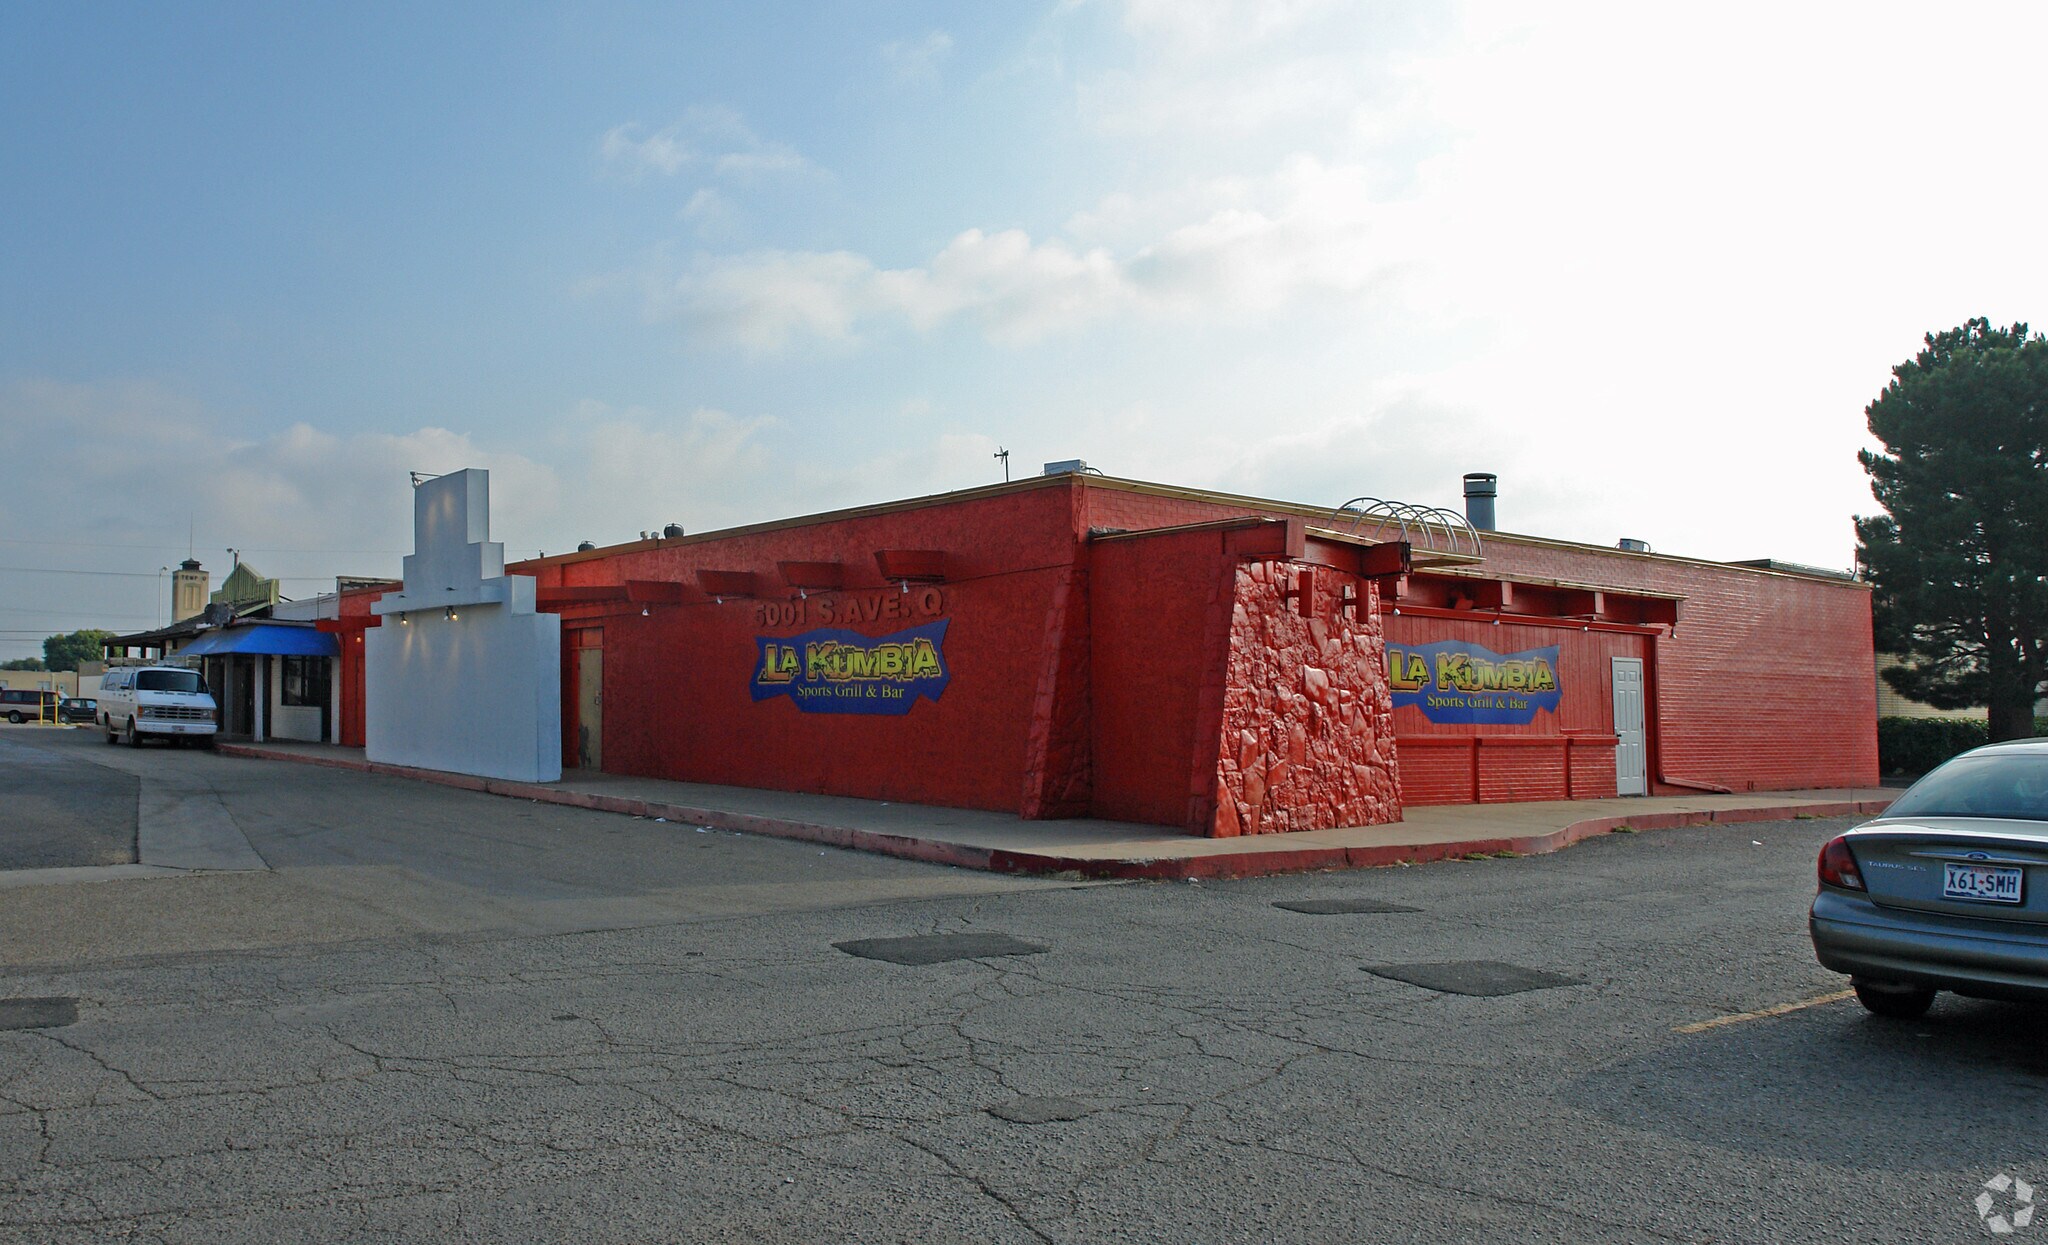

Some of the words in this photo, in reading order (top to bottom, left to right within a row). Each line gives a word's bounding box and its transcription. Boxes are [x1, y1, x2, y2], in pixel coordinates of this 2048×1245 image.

[919, 588, 945, 617] Q
[758, 644, 802, 684] LA
[806, 637, 942, 683] KUMBIA
[1388, 649, 1430, 692] LA
[1436, 652, 1557, 694] KUMBIA
[797, 684, 832, 700] Sports
[835, 684, 862, 698] Grill
[866, 684, 877, 698] &
[881, 684, 905, 699] Bar
[1427, 695, 1465, 710] Sports
[1467, 695, 1493, 709] Grill
[1496, 697, 1506, 709] &
[1509, 698, 1528, 711] Bar
